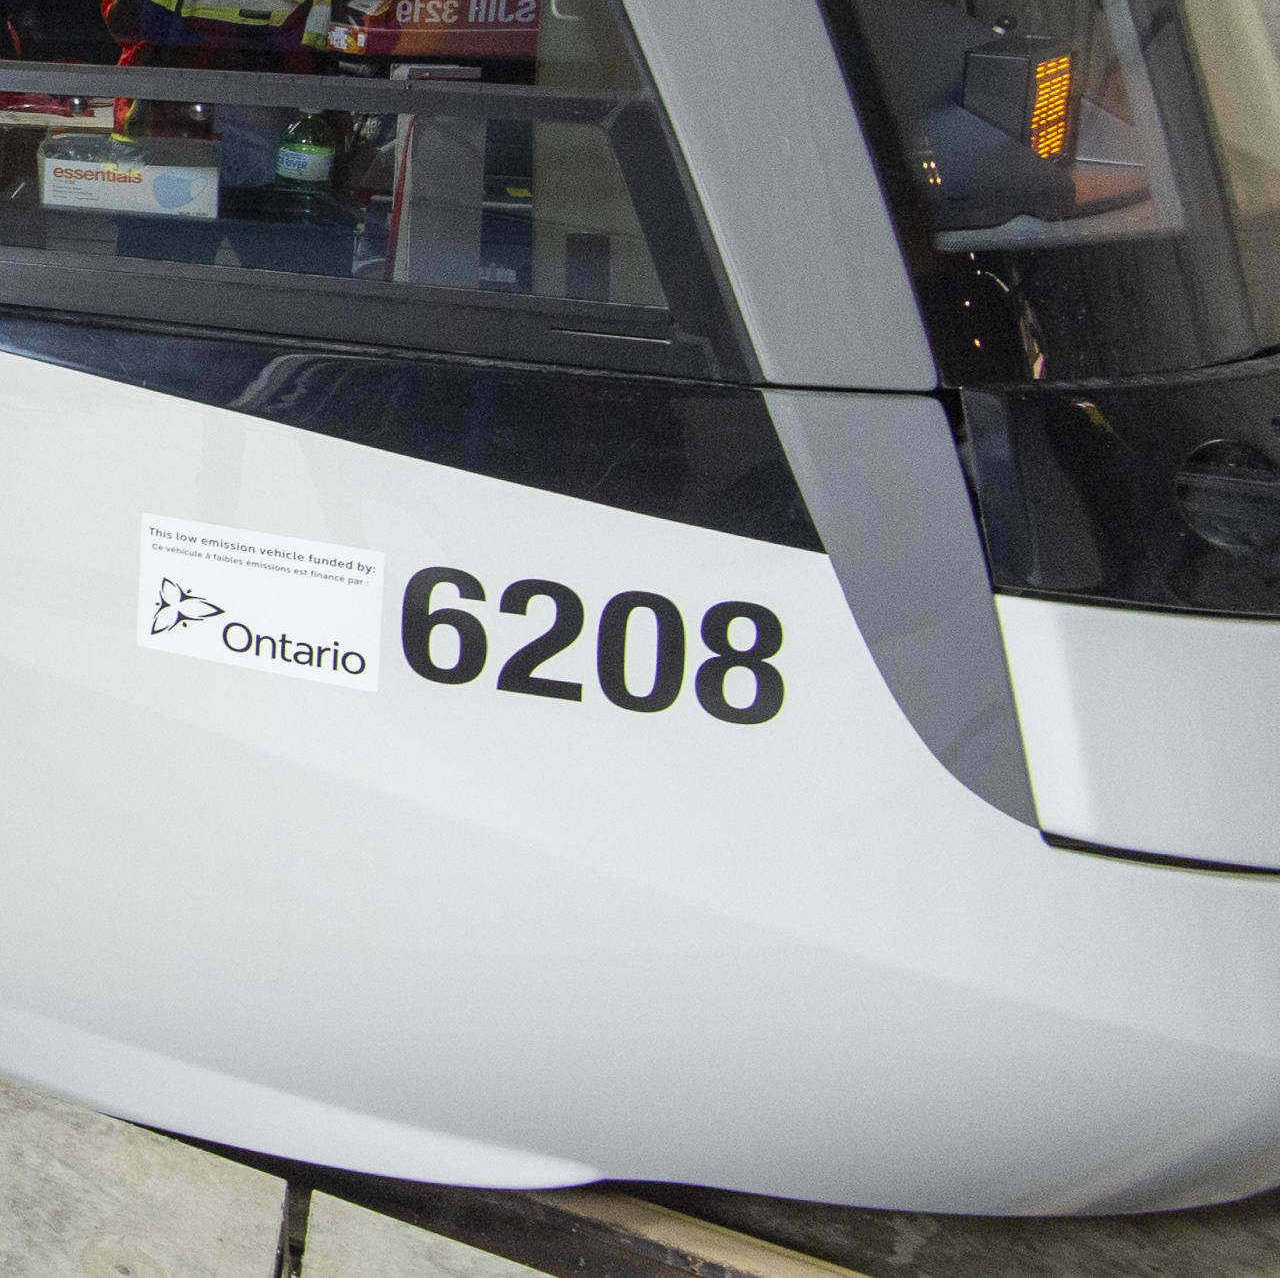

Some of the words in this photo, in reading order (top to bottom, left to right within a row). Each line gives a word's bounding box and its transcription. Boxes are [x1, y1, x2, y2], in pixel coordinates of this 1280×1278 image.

[53, 166, 143, 184] essentials
[149, 527, 172, 539] This
[176, 531, 197, 543] low
[201, 537, 255, 553] emission
[260, 547, 304, 562] vehicle
[309, 554, 353, 570] funded
[357, 562, 376, 574] by:
[152, 543, 164, 551] Ce
[166, 544, 203, 558] véhicule
[213, 553, 243, 565] faibles
[246, 559, 291, 573] émissions
[294, 567, 308, 576] est
[311, 570, 345, 582] financé
[348, 577, 363, 587] par
[222, 622, 366, 675] Ontario
[399, 565, 785, 726] 6208
